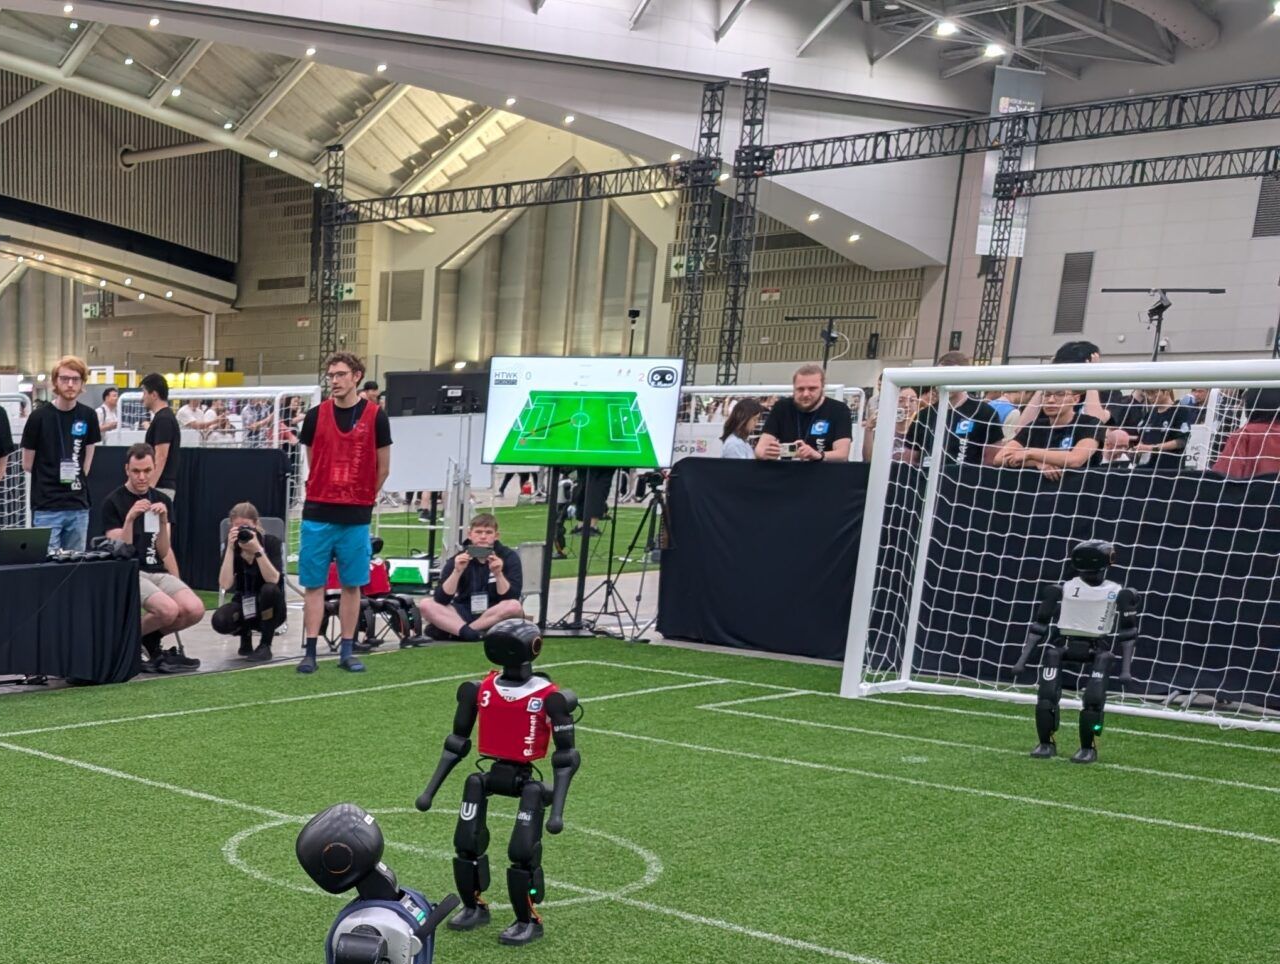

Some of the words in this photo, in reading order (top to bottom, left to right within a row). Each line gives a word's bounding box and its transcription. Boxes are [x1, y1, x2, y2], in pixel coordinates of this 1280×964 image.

[707, 234, 718, 253] 2
[494, 371, 518, 379] HTWK
[1071, 586, 1081, 598] 1
[480, 690, 492, 708] 3
[523, 714, 537, 757] B-Human
[460, 801, 479, 822] U
